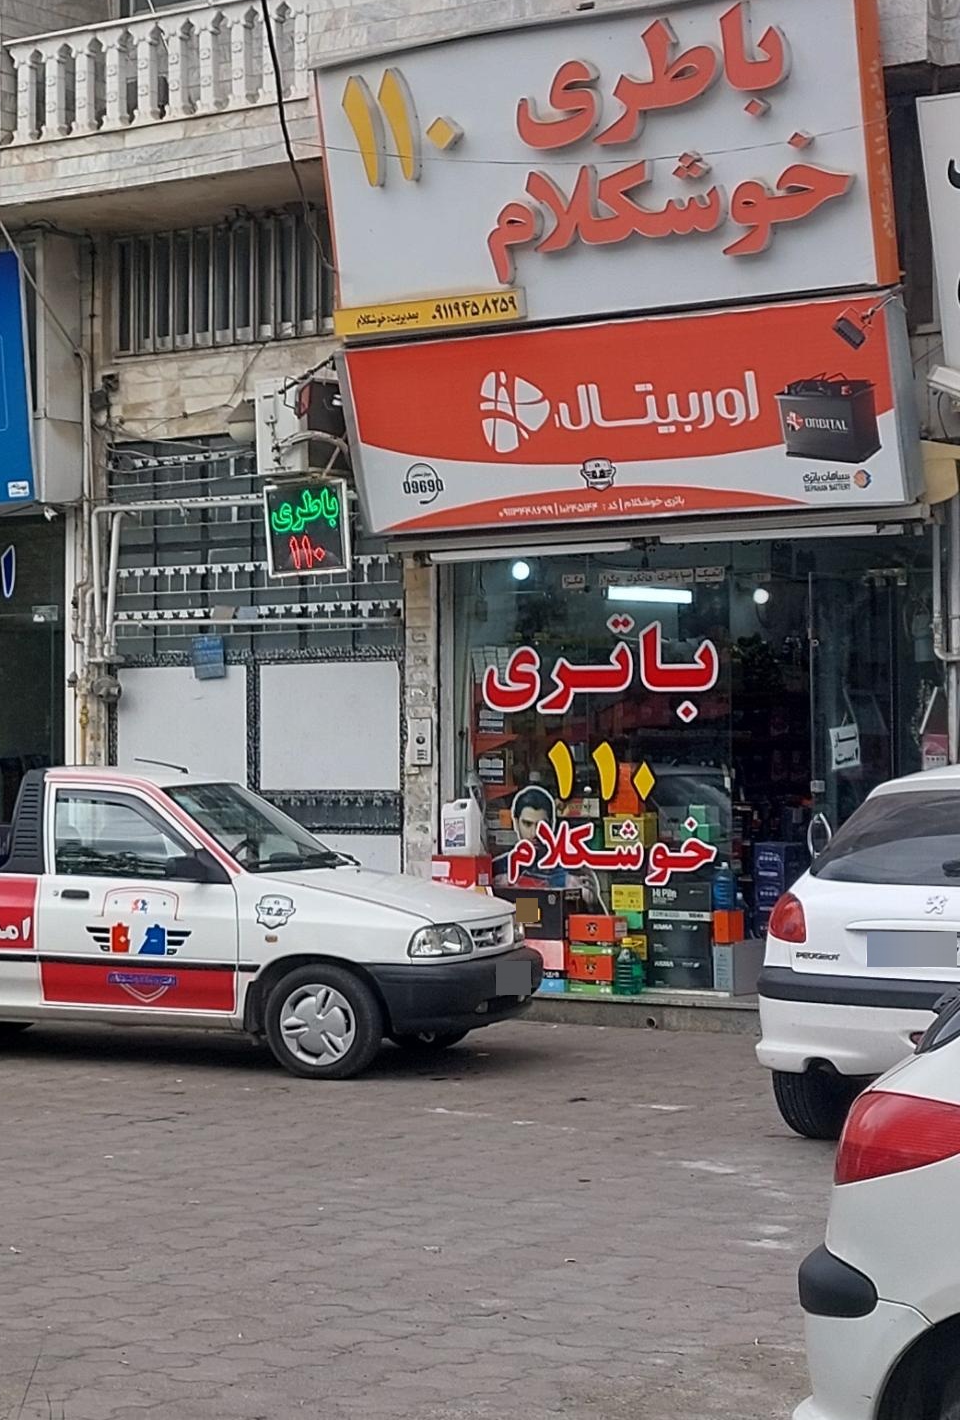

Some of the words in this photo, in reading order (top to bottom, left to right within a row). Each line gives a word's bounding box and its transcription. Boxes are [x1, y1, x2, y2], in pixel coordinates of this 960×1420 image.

[515, 1, 791, 149] باطری
[342, 67, 464, 188] ۱۱۰
[487, 130, 856, 284] خوشکلام
[554, 370, 760, 432] اوربیتال
[804, 417, 848, 431] ORBITAL
[272, 488, 339, 532] باطری
[403, 478, 444, 494] 09690
[289, 535, 326, 569] ۱۱۰
[482, 613, 719, 724] باتری
[546, 739, 657, 802] ۱۱۰
[507, 817, 719, 885] خوشکلام
[795, 951, 840, 961] PEUGEOT
